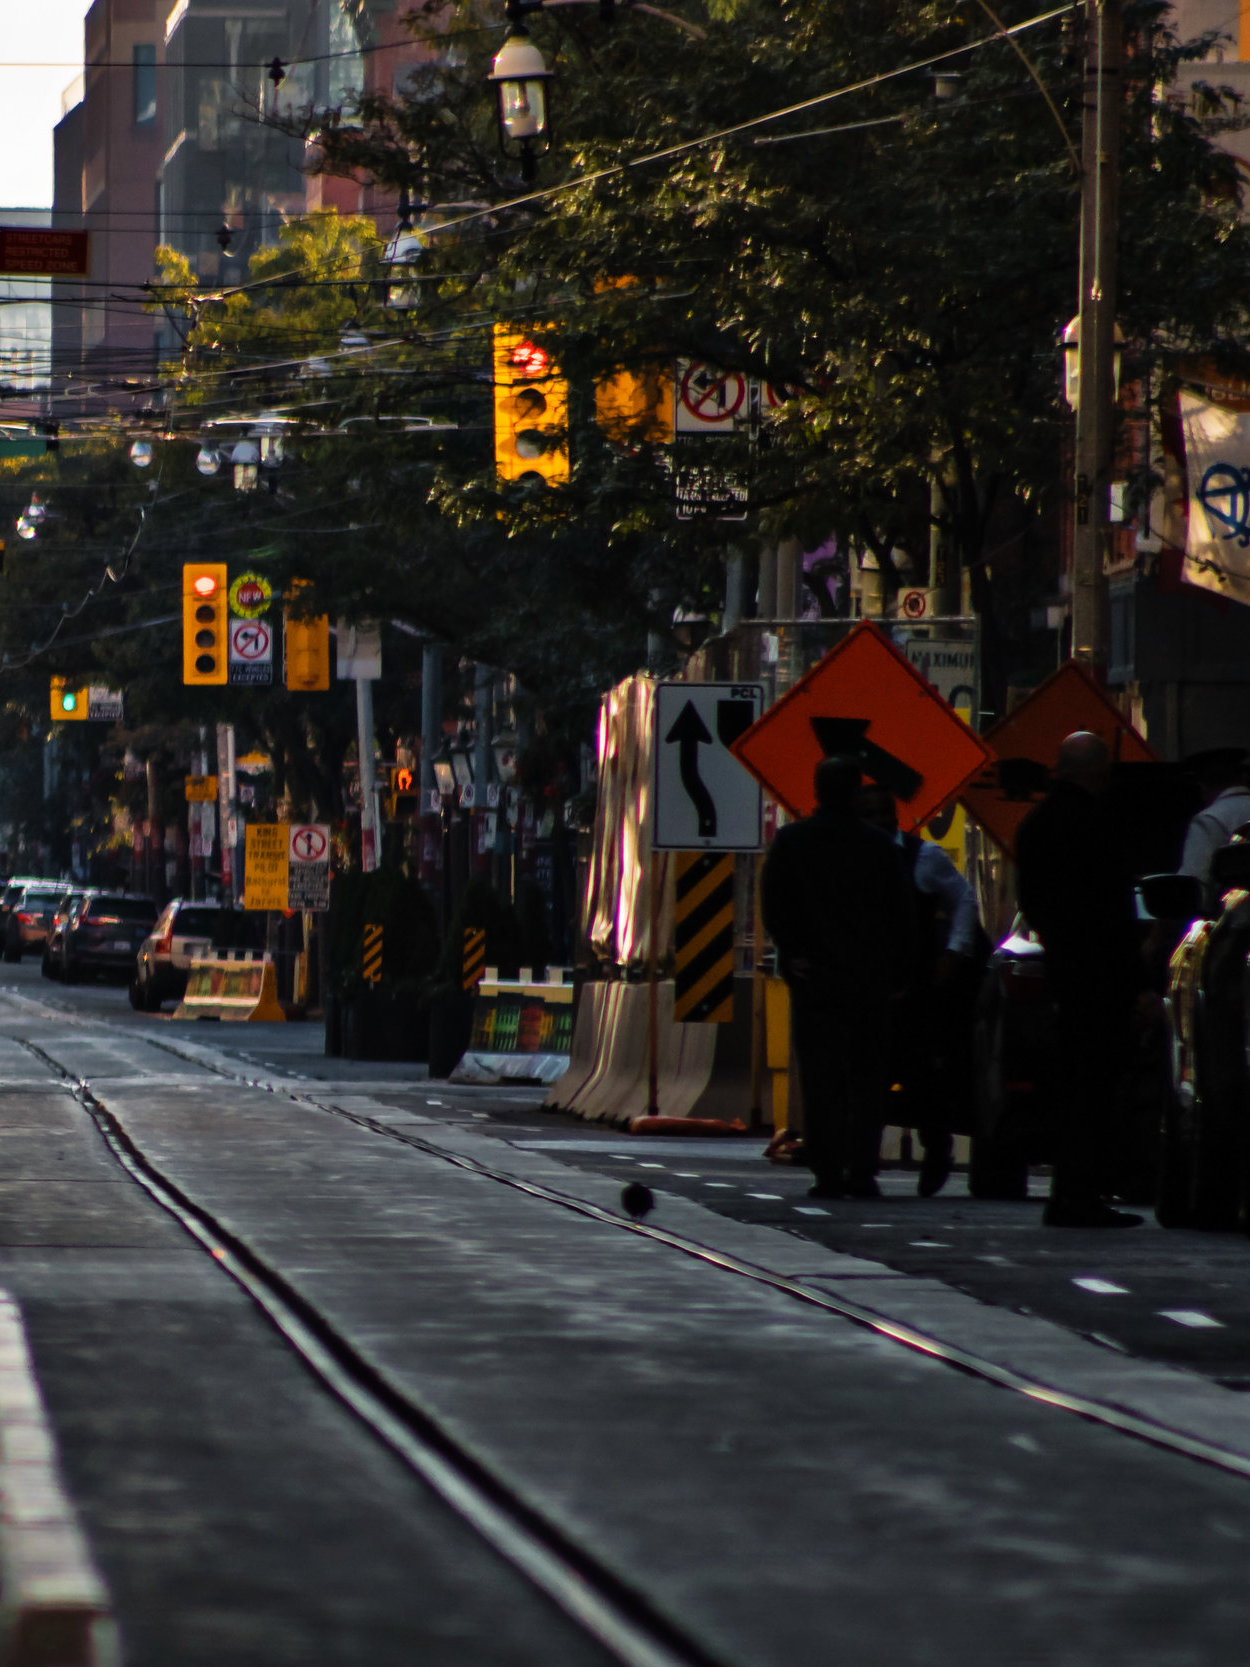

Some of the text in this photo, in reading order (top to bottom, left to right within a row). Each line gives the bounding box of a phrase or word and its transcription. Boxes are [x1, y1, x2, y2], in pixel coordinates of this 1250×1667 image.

[5, 231, 72, 245] STREETCARS
[5, 246, 69, 258] RESTRICTED
[5, 259, 78, 272] SPEED ZONE
[731, 688, 757, 698] PCL
[257, 828, 277, 837] KING
[250, 840, 283, 849] STREET
[248, 851, 285, 861] TRANSIT
[254, 863, 278, 873] PILOT
